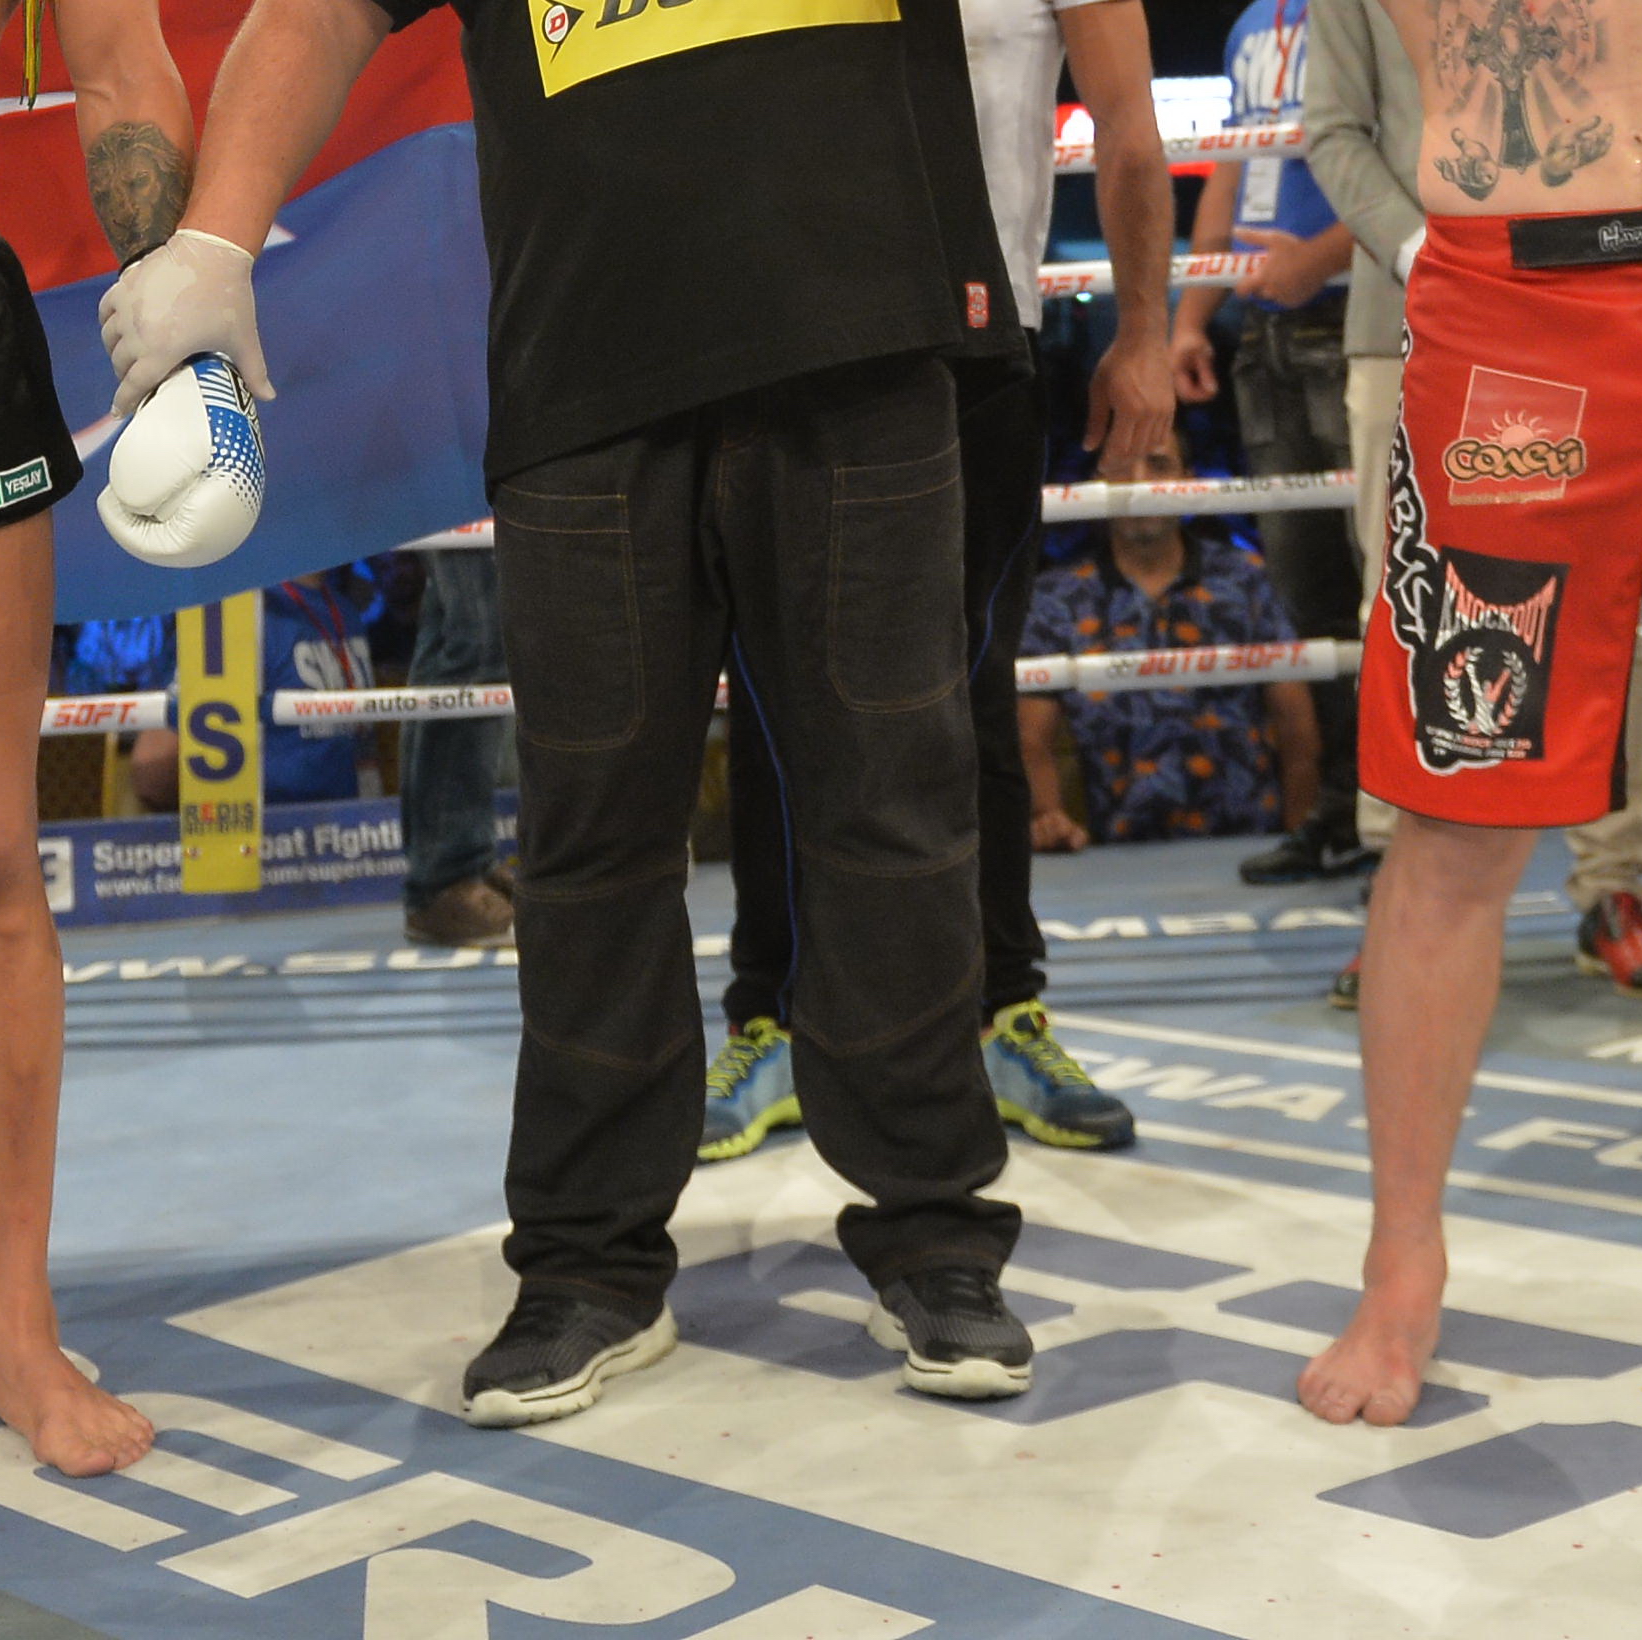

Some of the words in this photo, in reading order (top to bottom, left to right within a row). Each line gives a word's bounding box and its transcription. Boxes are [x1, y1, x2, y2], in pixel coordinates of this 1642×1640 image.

[1137, 645, 1217, 676] AUTO
[294, 688, 510, 717] www.auto-soft.ro
[314, 817, 402, 856] Fighti
